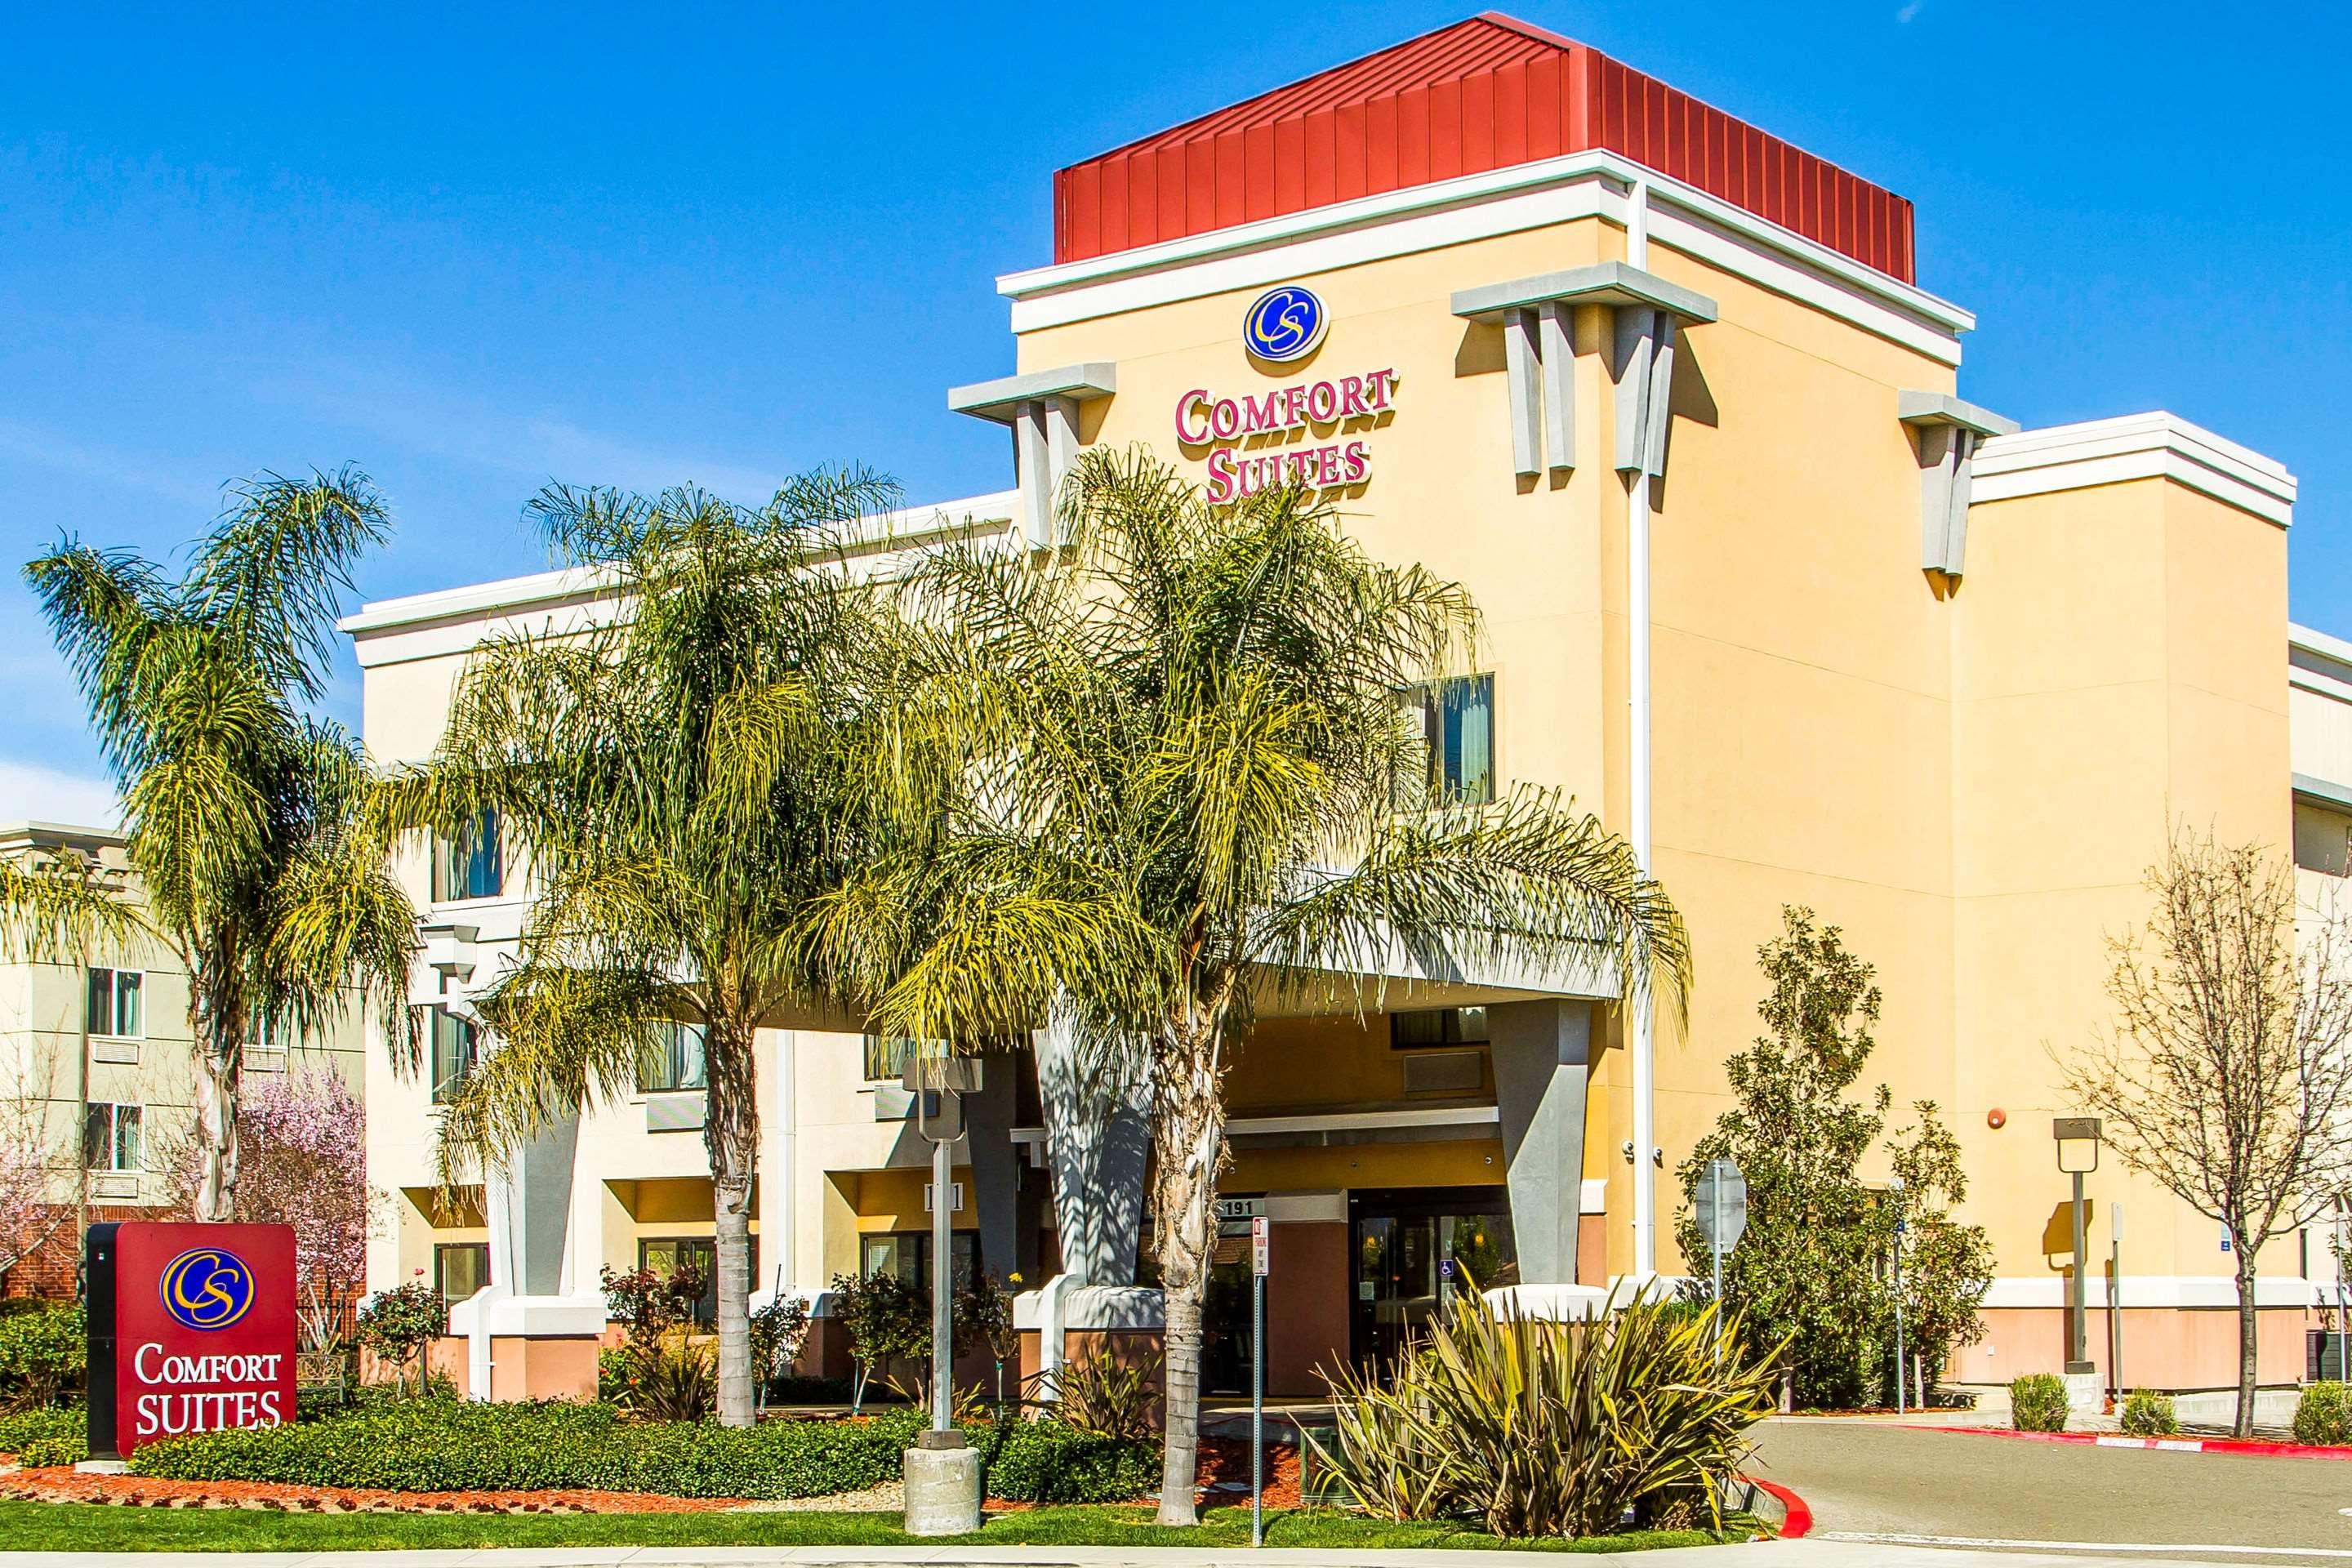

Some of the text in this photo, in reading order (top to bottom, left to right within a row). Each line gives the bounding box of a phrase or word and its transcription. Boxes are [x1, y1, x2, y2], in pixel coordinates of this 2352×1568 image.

[1175, 368, 1396, 445] COMFORT
[1206, 441, 1368, 505] SUITES
[134, 1343, 282, 1384] COMFORT
[136, 1390, 281, 1435] SUITES
